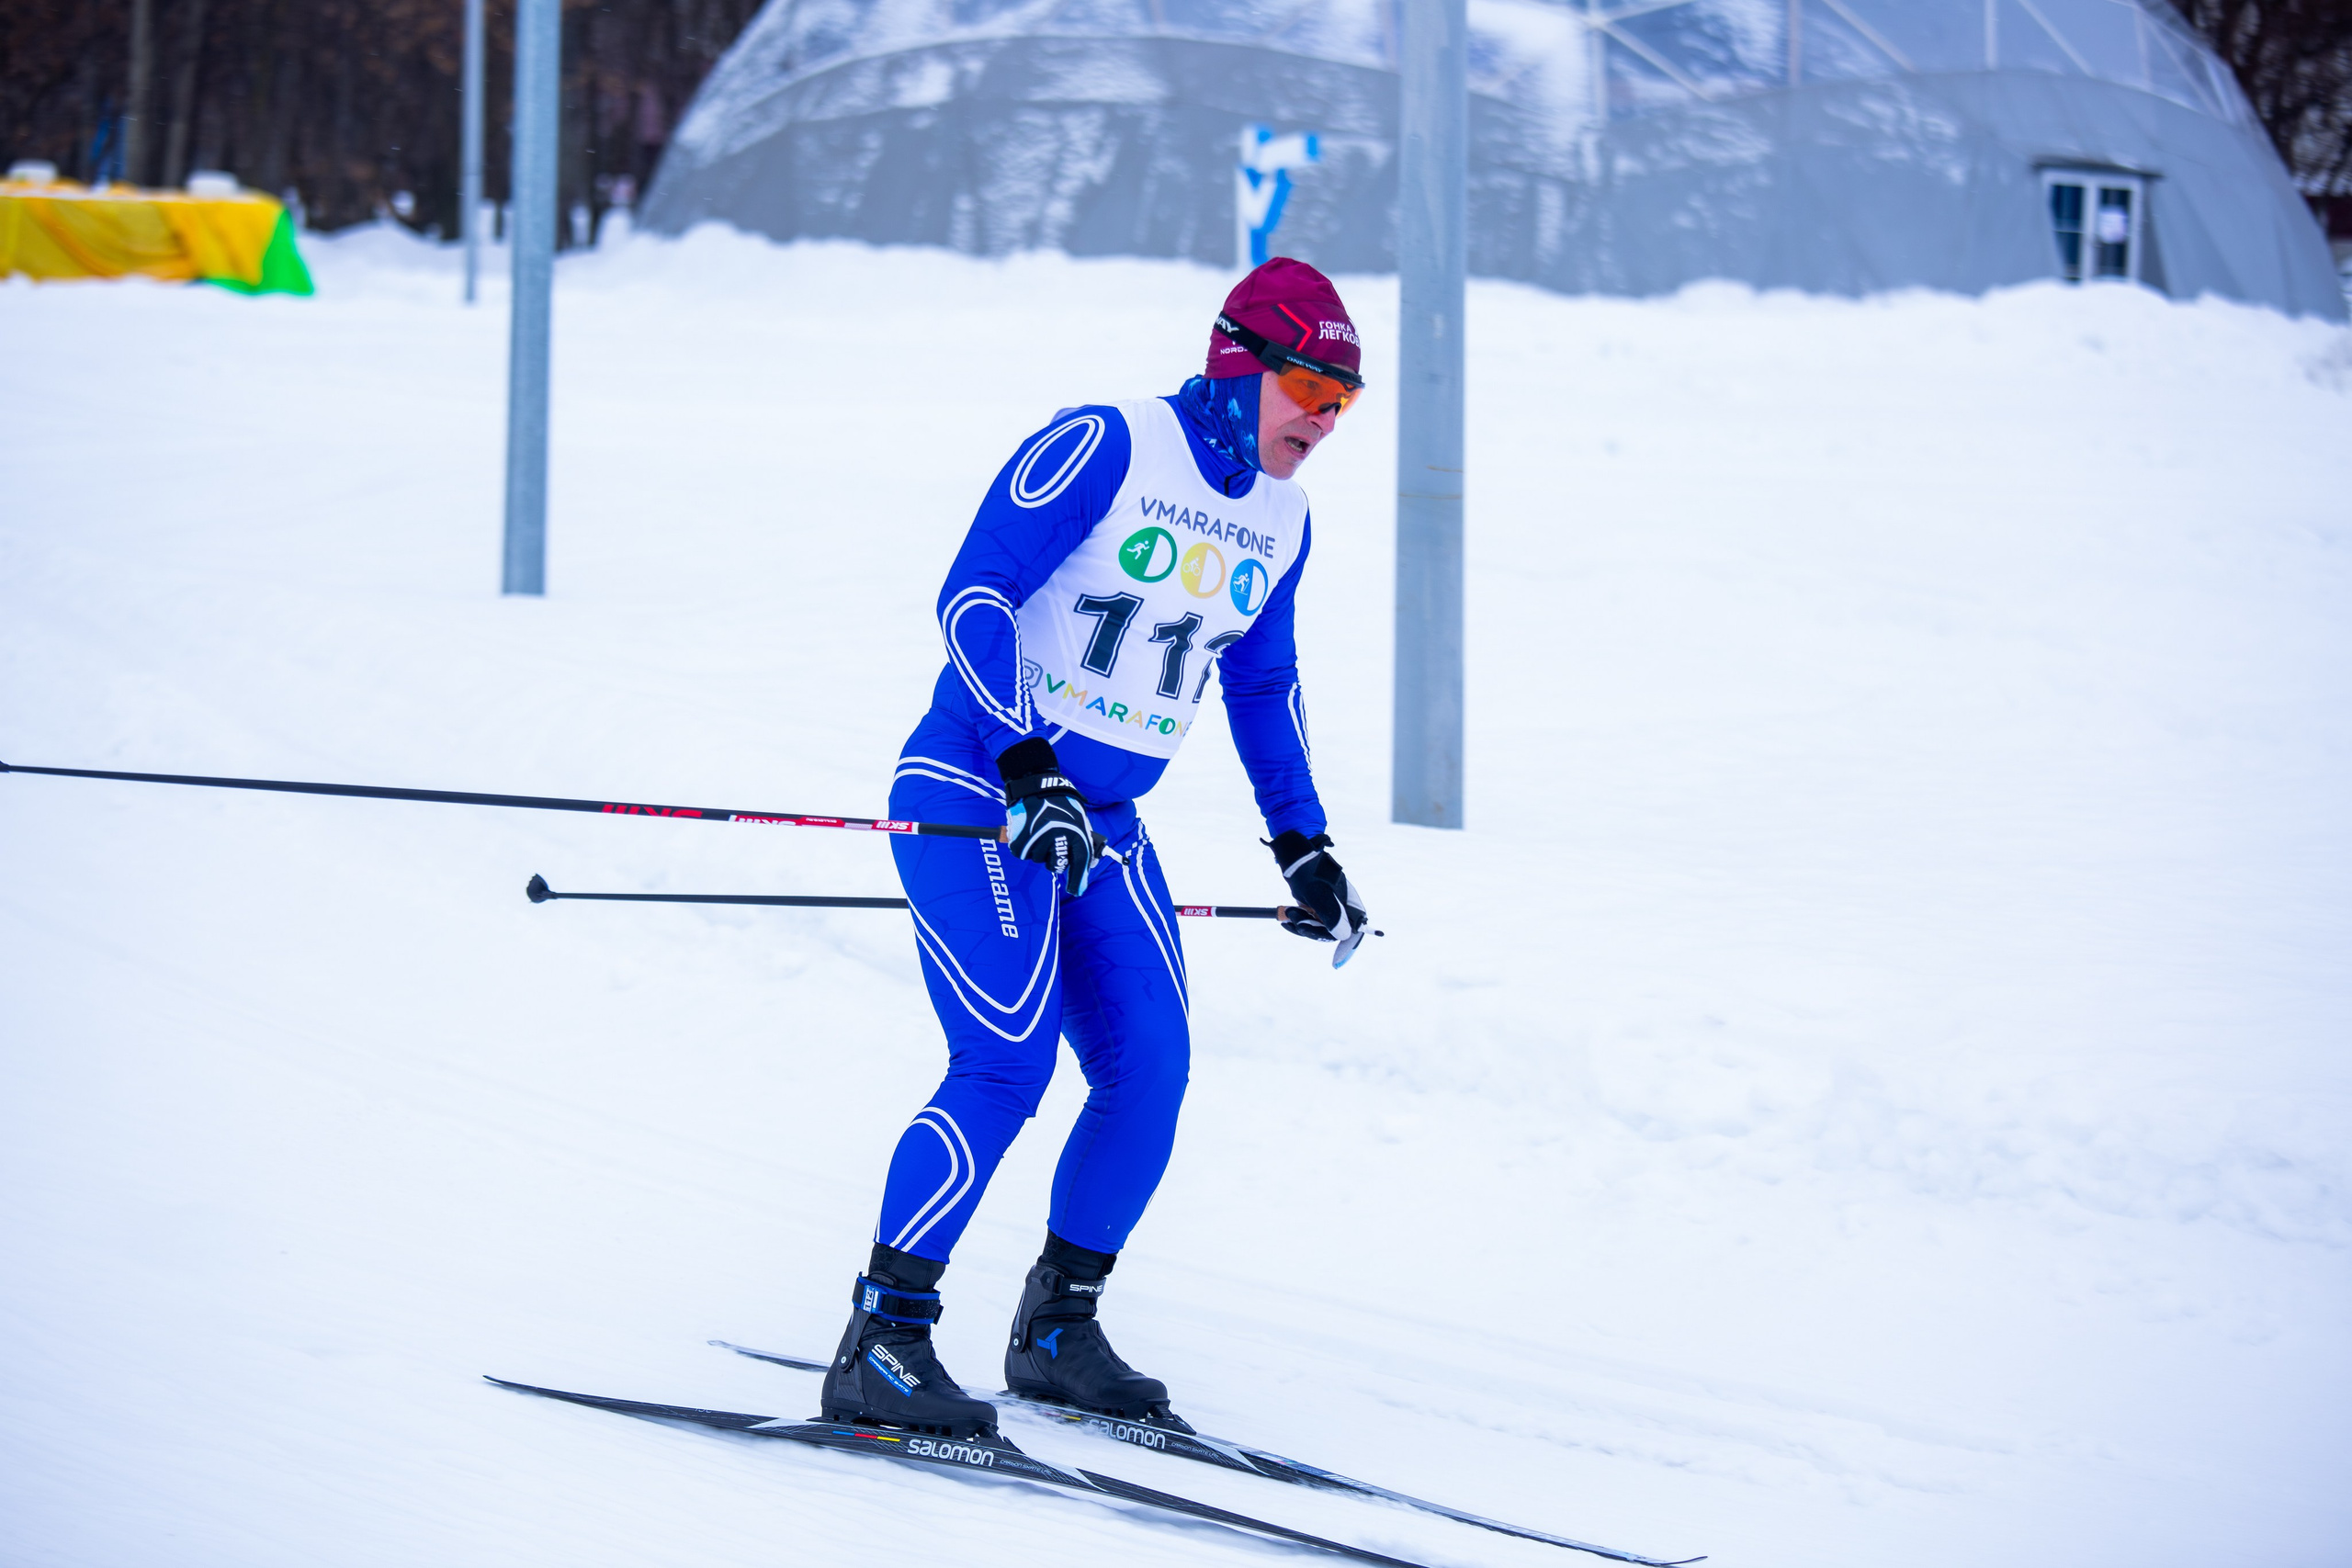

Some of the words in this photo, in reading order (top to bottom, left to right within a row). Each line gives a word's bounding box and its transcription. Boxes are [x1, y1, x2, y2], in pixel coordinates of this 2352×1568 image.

[1319, 321, 1351, 333] ГОНКА
[1140, 496, 1275, 558] VMARAFONE
[1069, 1284, 1102, 1292] SPINE
[871, 1344, 921, 1387] SPINE
